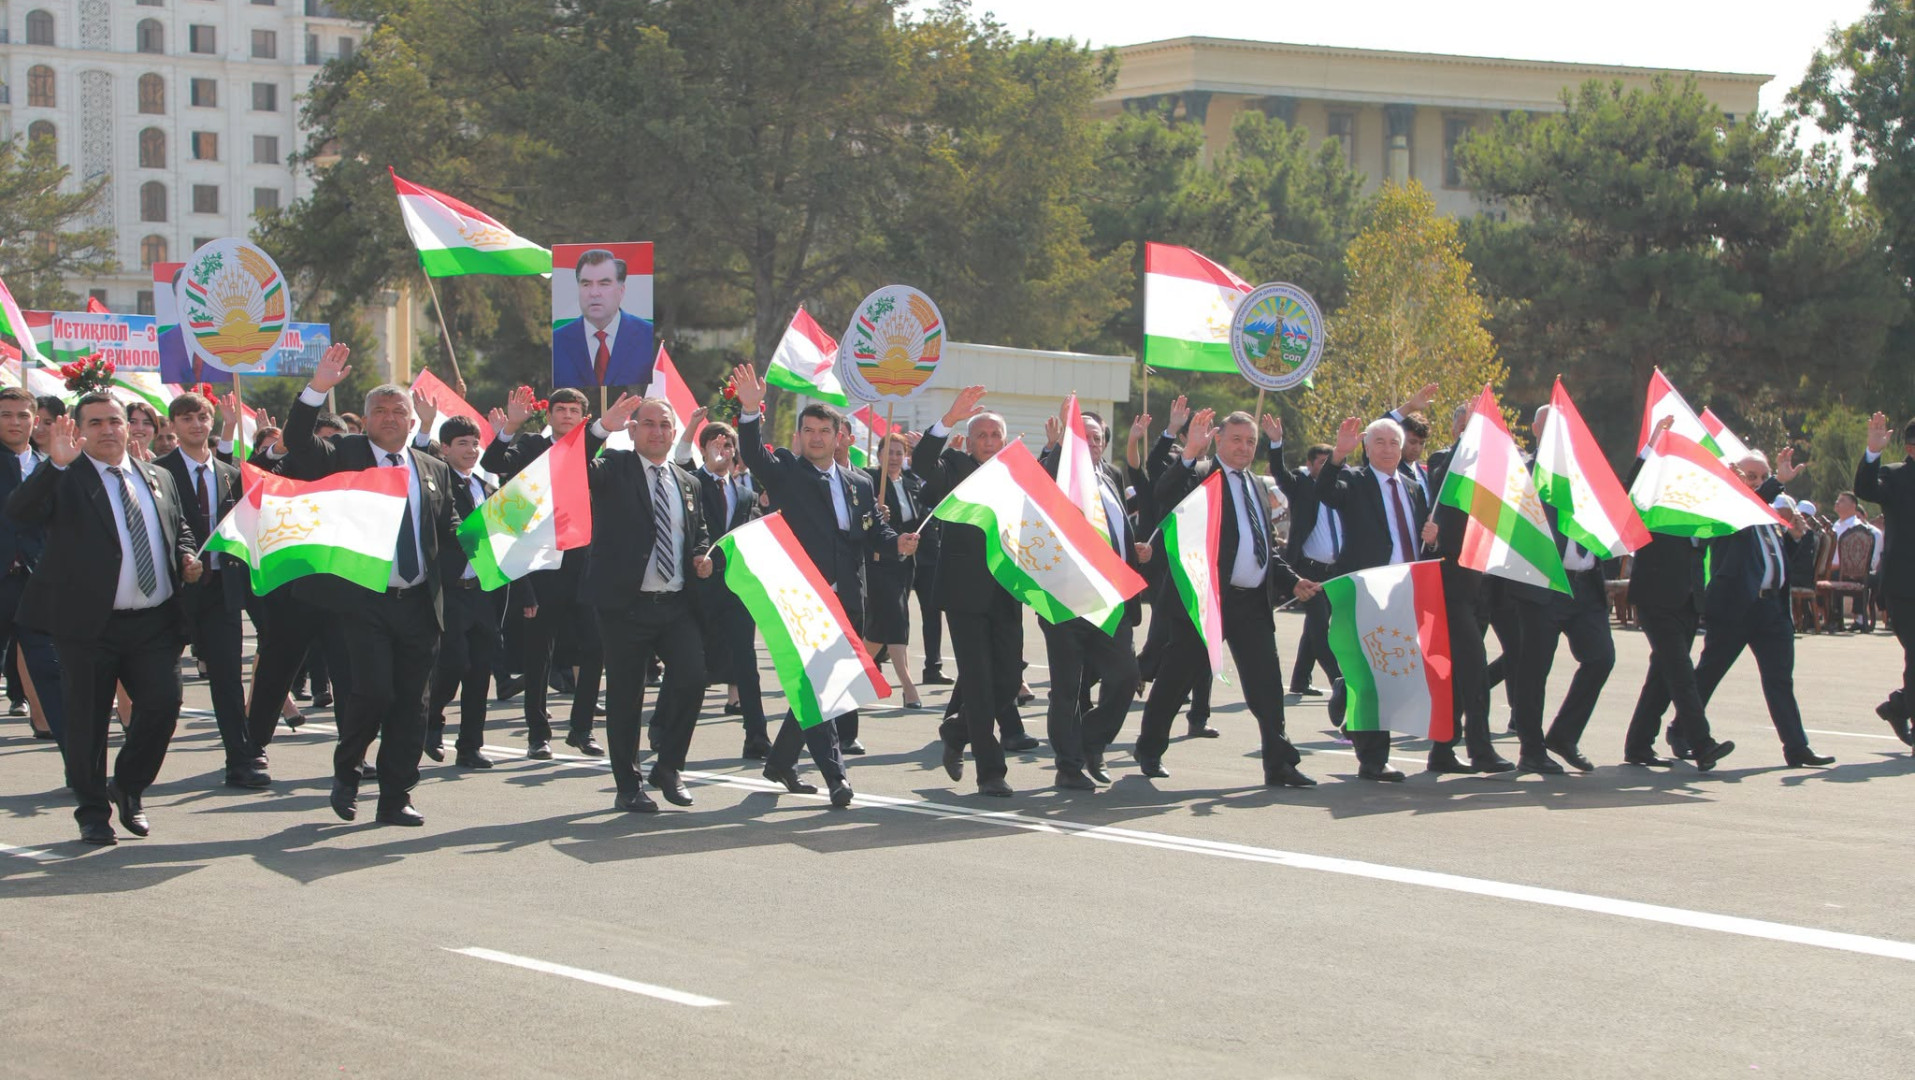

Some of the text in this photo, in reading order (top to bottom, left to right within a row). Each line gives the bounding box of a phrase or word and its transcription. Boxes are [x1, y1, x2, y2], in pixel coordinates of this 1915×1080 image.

[54, 318, 128, 343] Истиқлол
[1281, 331, 1308, 352] 35
[98, 348, 160, 367] техноло
